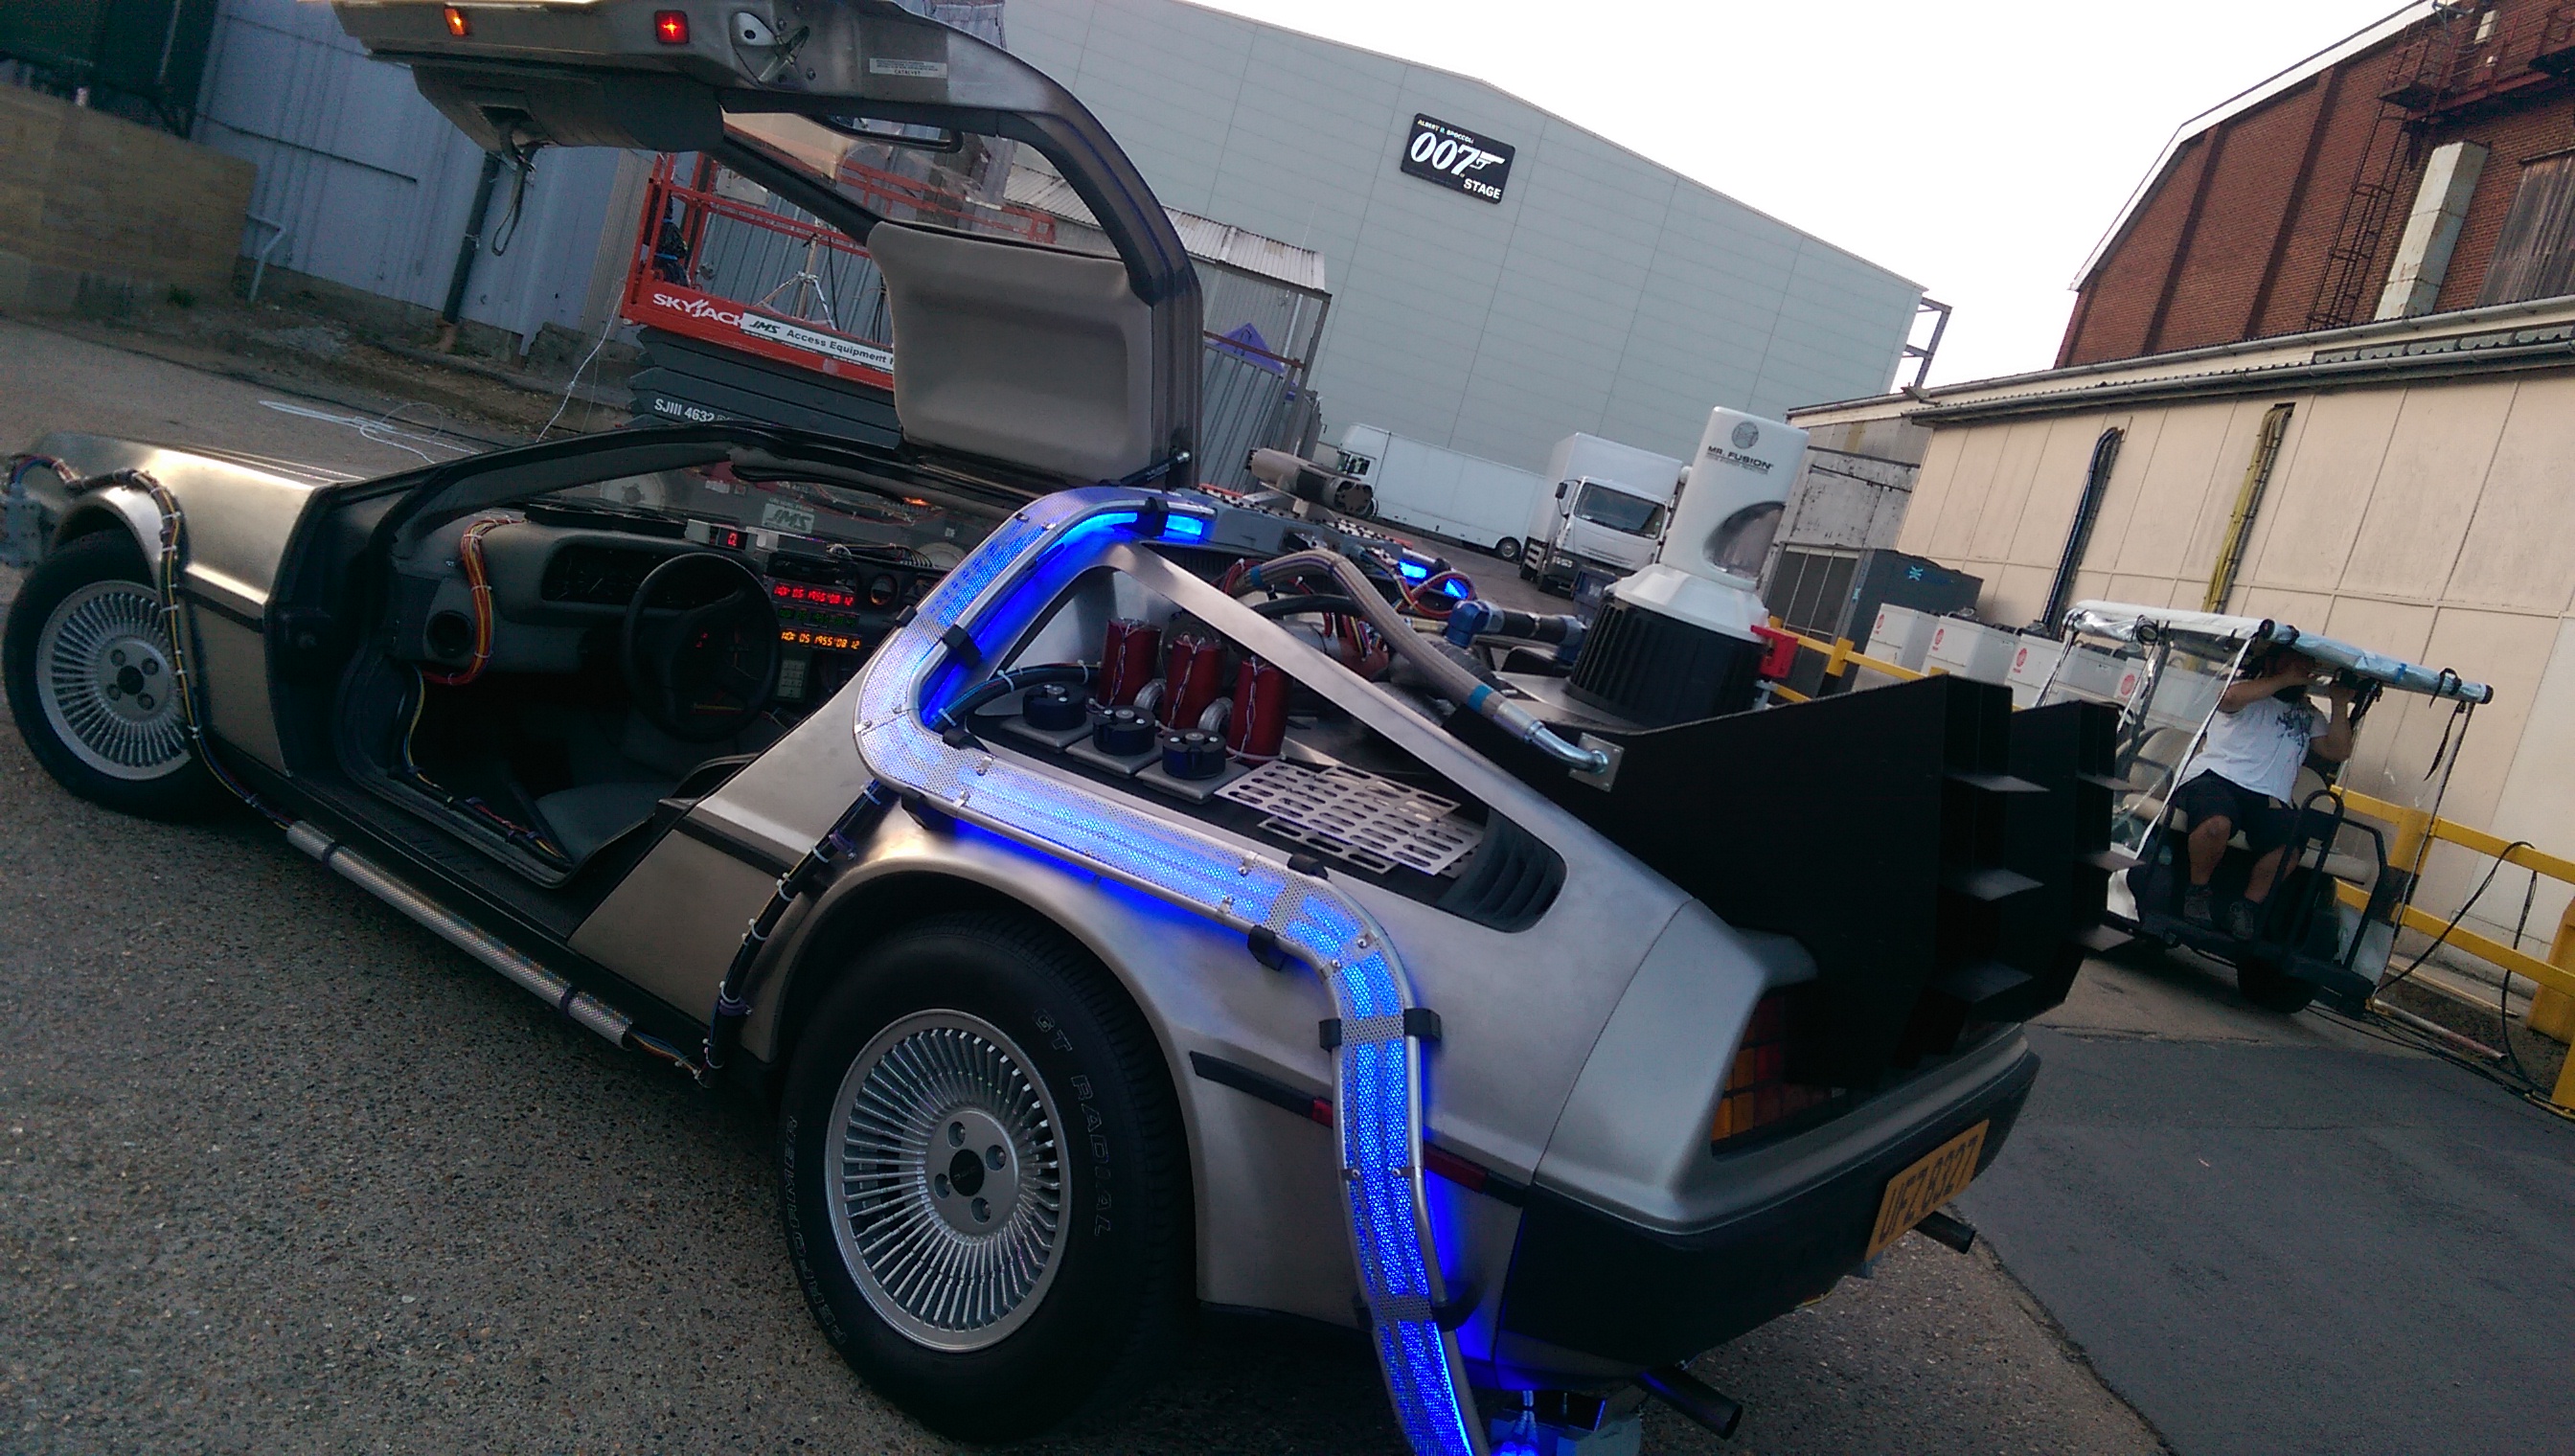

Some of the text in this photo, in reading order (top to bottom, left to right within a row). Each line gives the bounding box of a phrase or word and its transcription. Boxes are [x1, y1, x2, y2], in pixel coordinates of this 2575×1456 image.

[1411, 132, 1482, 175] 007
[1463, 178, 1501, 199] STAGE
[749, 320, 781, 335] JMS
[786, 329, 827, 347] Access
[829, 341, 887, 364] Equipment
[684, 407, 716, 422] 4632
[1728, 451, 1772, 469] FUSION
[1033, 1008, 1112, 1237] GT RADIAL
